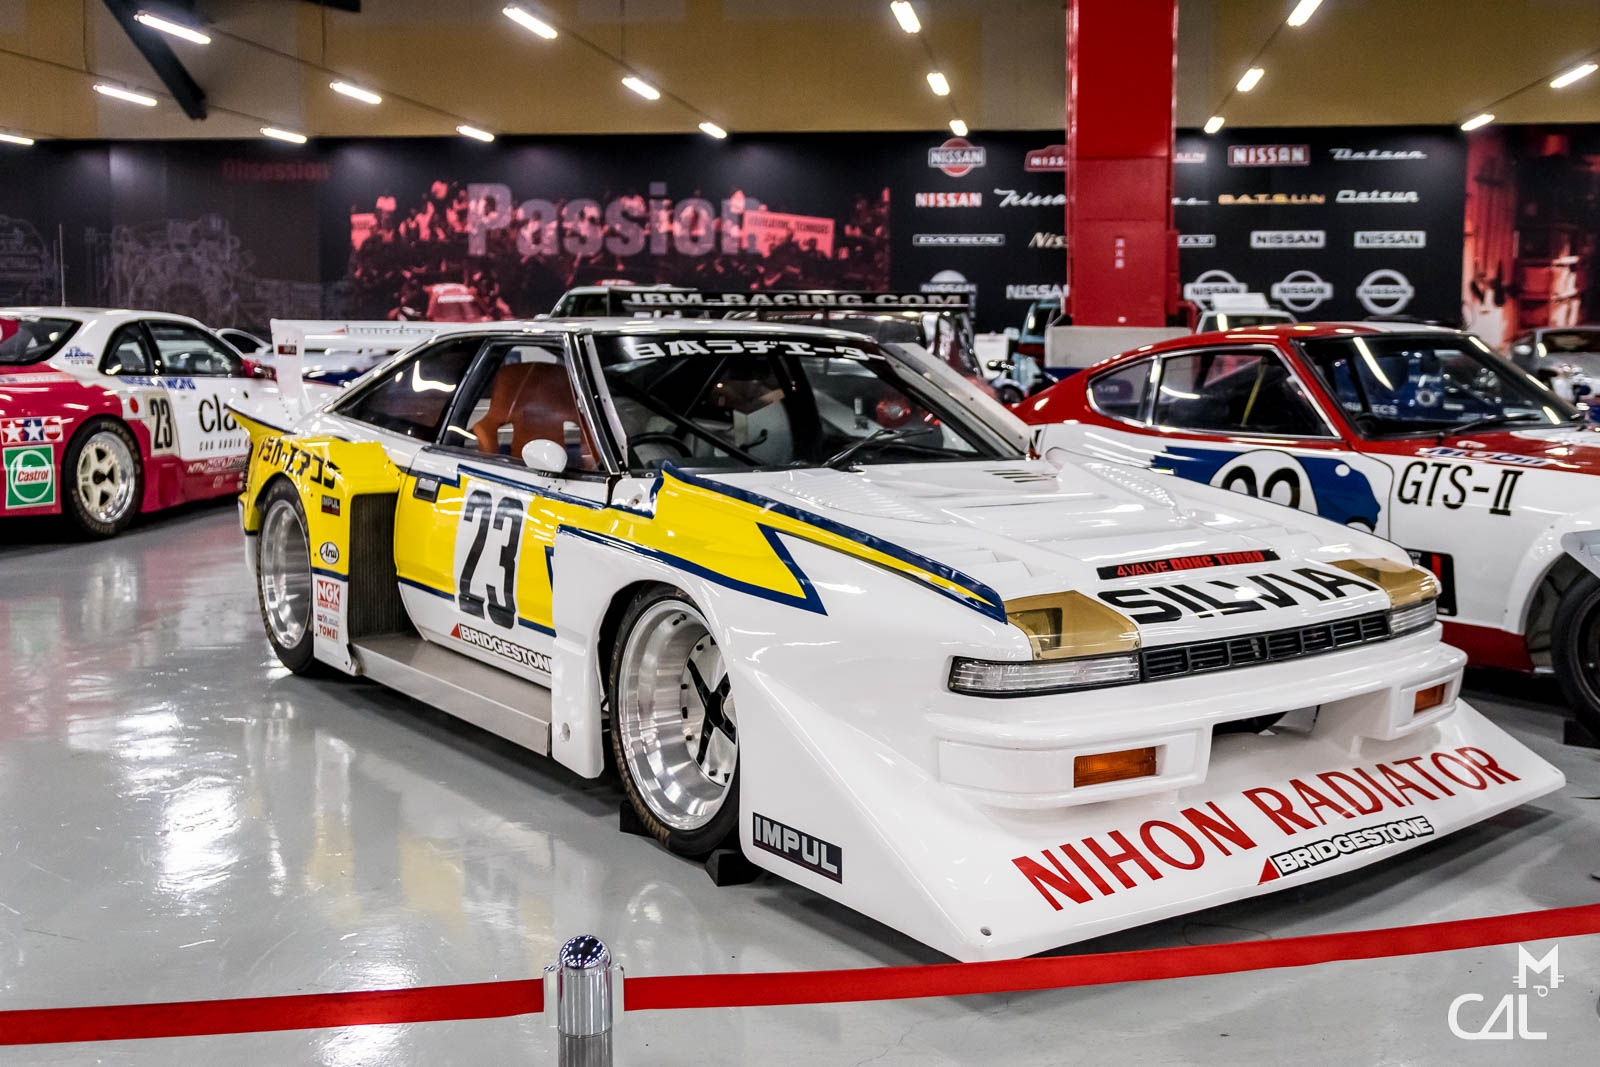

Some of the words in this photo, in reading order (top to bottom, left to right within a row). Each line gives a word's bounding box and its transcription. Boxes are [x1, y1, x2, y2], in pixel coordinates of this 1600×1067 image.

[1030, 156, 1066, 167] NISS
[1233, 147, 1305, 163] NISSAN
[915, 192, 982, 207] NISSAN
[1218, 193, 1326, 205] DATSUN
[467, 182, 762, 256] Passion
[1256, 234, 1319, 244] NISSAN
[1359, 234, 1419, 244] NISSAN
[1278, 286, 1325, 295] NISSAN
[149, 397, 173, 450] 23
[17, 470, 49, 482] Castrol
[458, 488, 524, 630] 23
[1168, 555, 1215, 571] DOHC
[1213, 550, 1265, 566] TURBO
[317, 580, 340, 605] NGK
[1097, 567, 1379, 625] SILVIA
[319, 624, 338, 641] TOMEI
[1011, 801, 1258, 911] NIHON
[1242, 746, 1522, 836] RADIATOR
[754, 815, 838, 874] IMPUL
[1276, 816, 1435, 875] BRIDGESTONE
